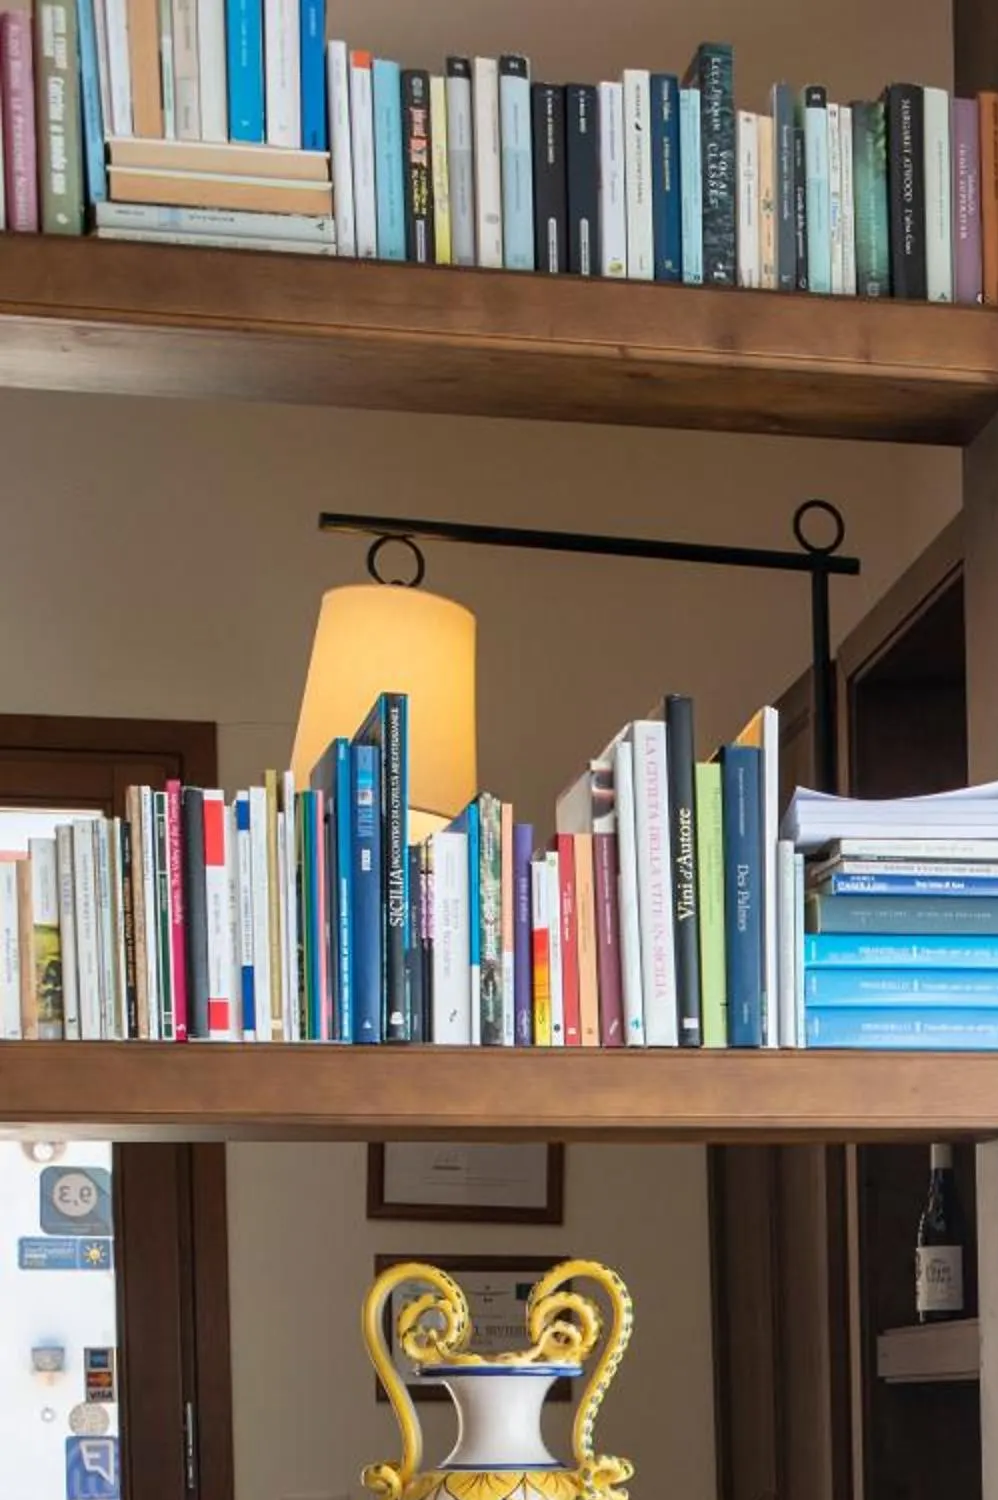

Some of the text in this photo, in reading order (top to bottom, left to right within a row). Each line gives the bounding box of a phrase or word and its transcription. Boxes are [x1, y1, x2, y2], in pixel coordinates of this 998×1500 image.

[903, 155, 913, 203] ATWOOD
[644, 735, 657, 755] LA
[391, 820, 401, 868] INCONTRO
[648, 825, 665, 876] DELLA
[676, 807, 696, 921] Vini d'Autore
[389, 868, 404, 927] SICILIA
[650, 880, 666, 917] VITE
[737, 863, 750, 933] Des Palmes
[652, 921, 666, 942] IN
[653, 944, 668, 999] SICILIA
[88, 1390, 113, 1401] VISA
